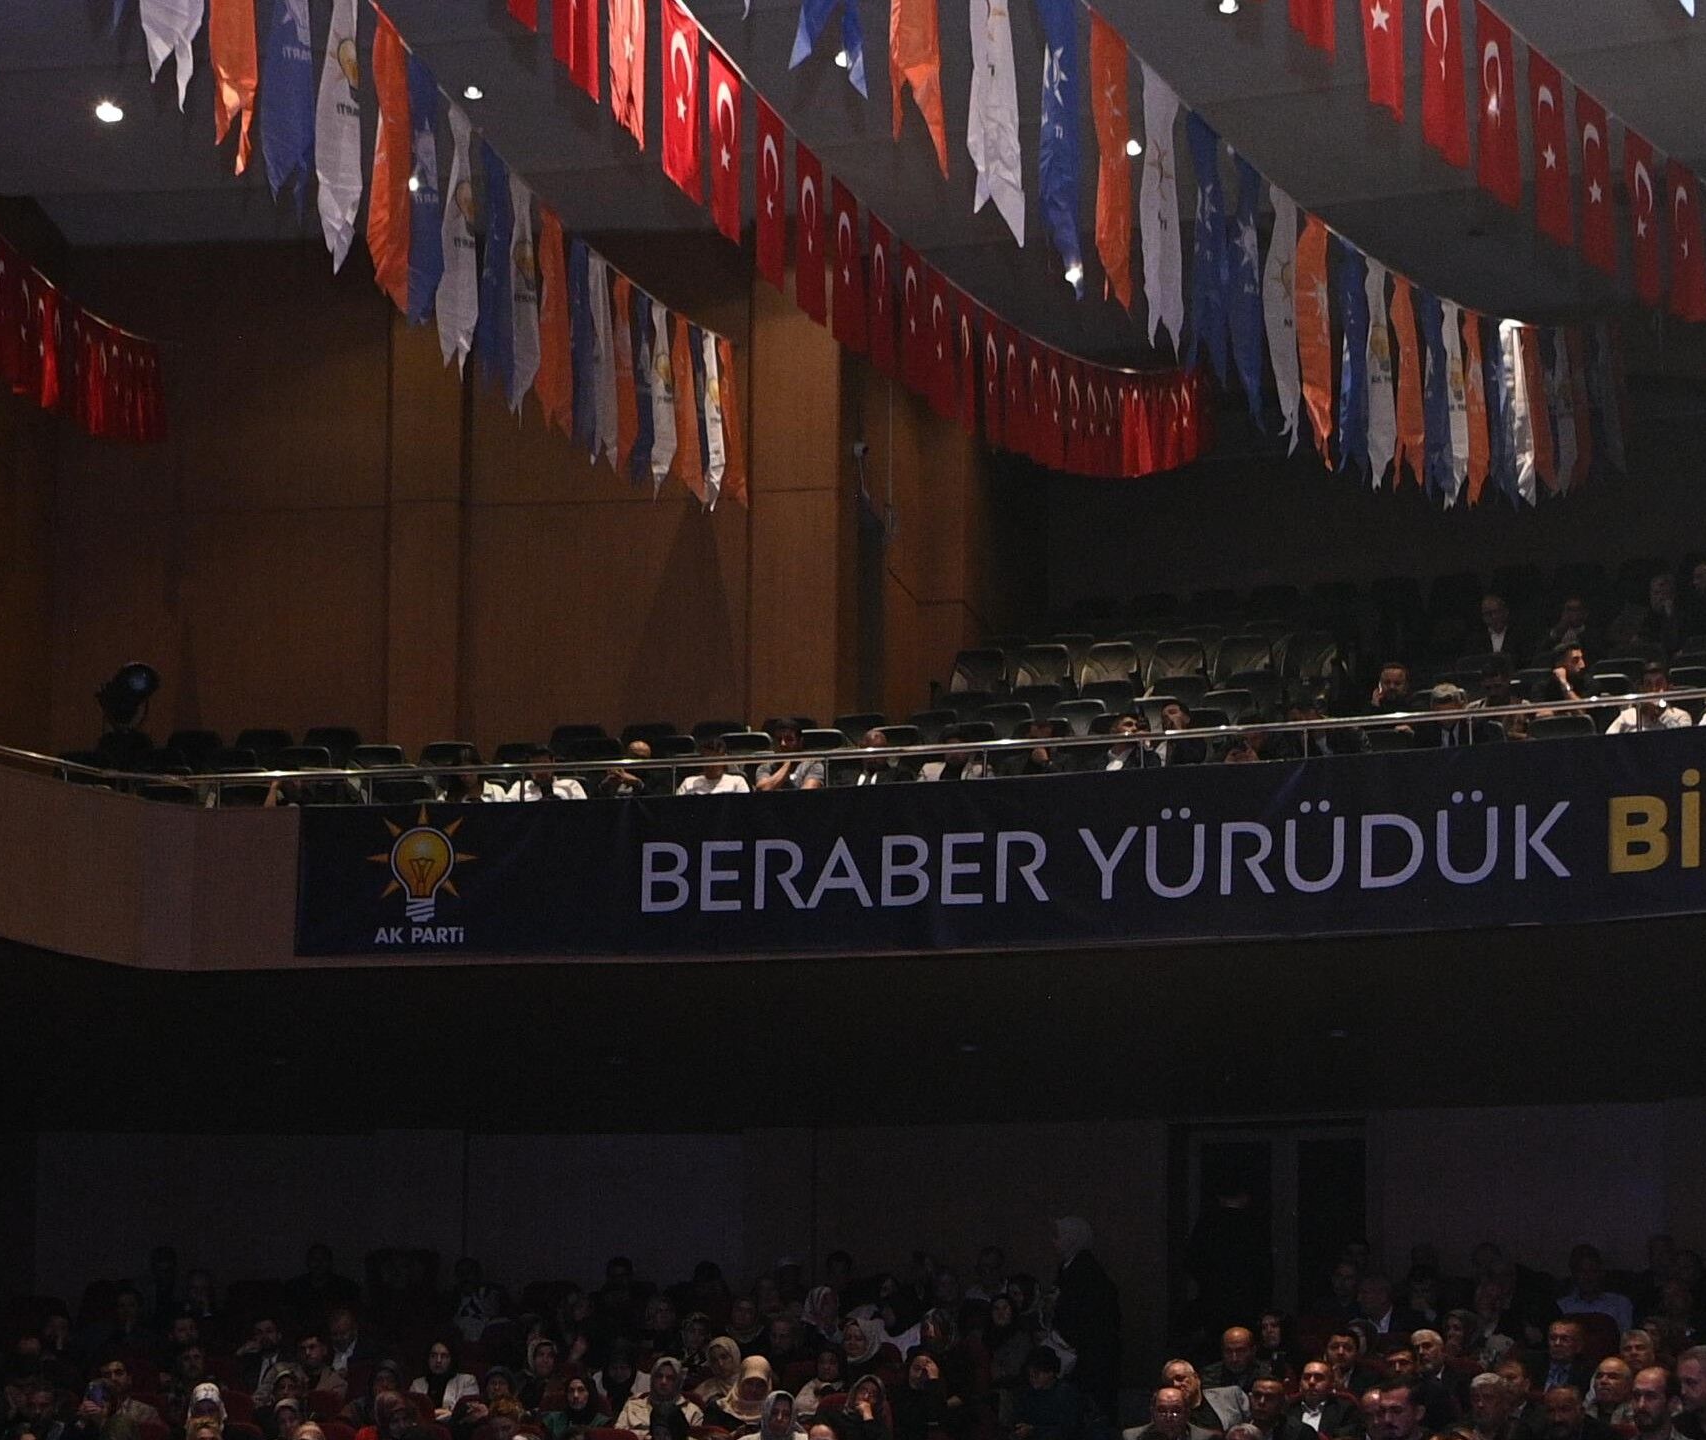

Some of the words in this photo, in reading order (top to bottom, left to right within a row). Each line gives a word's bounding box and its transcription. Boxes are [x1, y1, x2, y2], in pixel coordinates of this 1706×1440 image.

[641, 830, 1050, 913] BERABER
[1078, 789, 1571, 901] YÜRÜDÜK
[374, 927, 403, 944] AK
